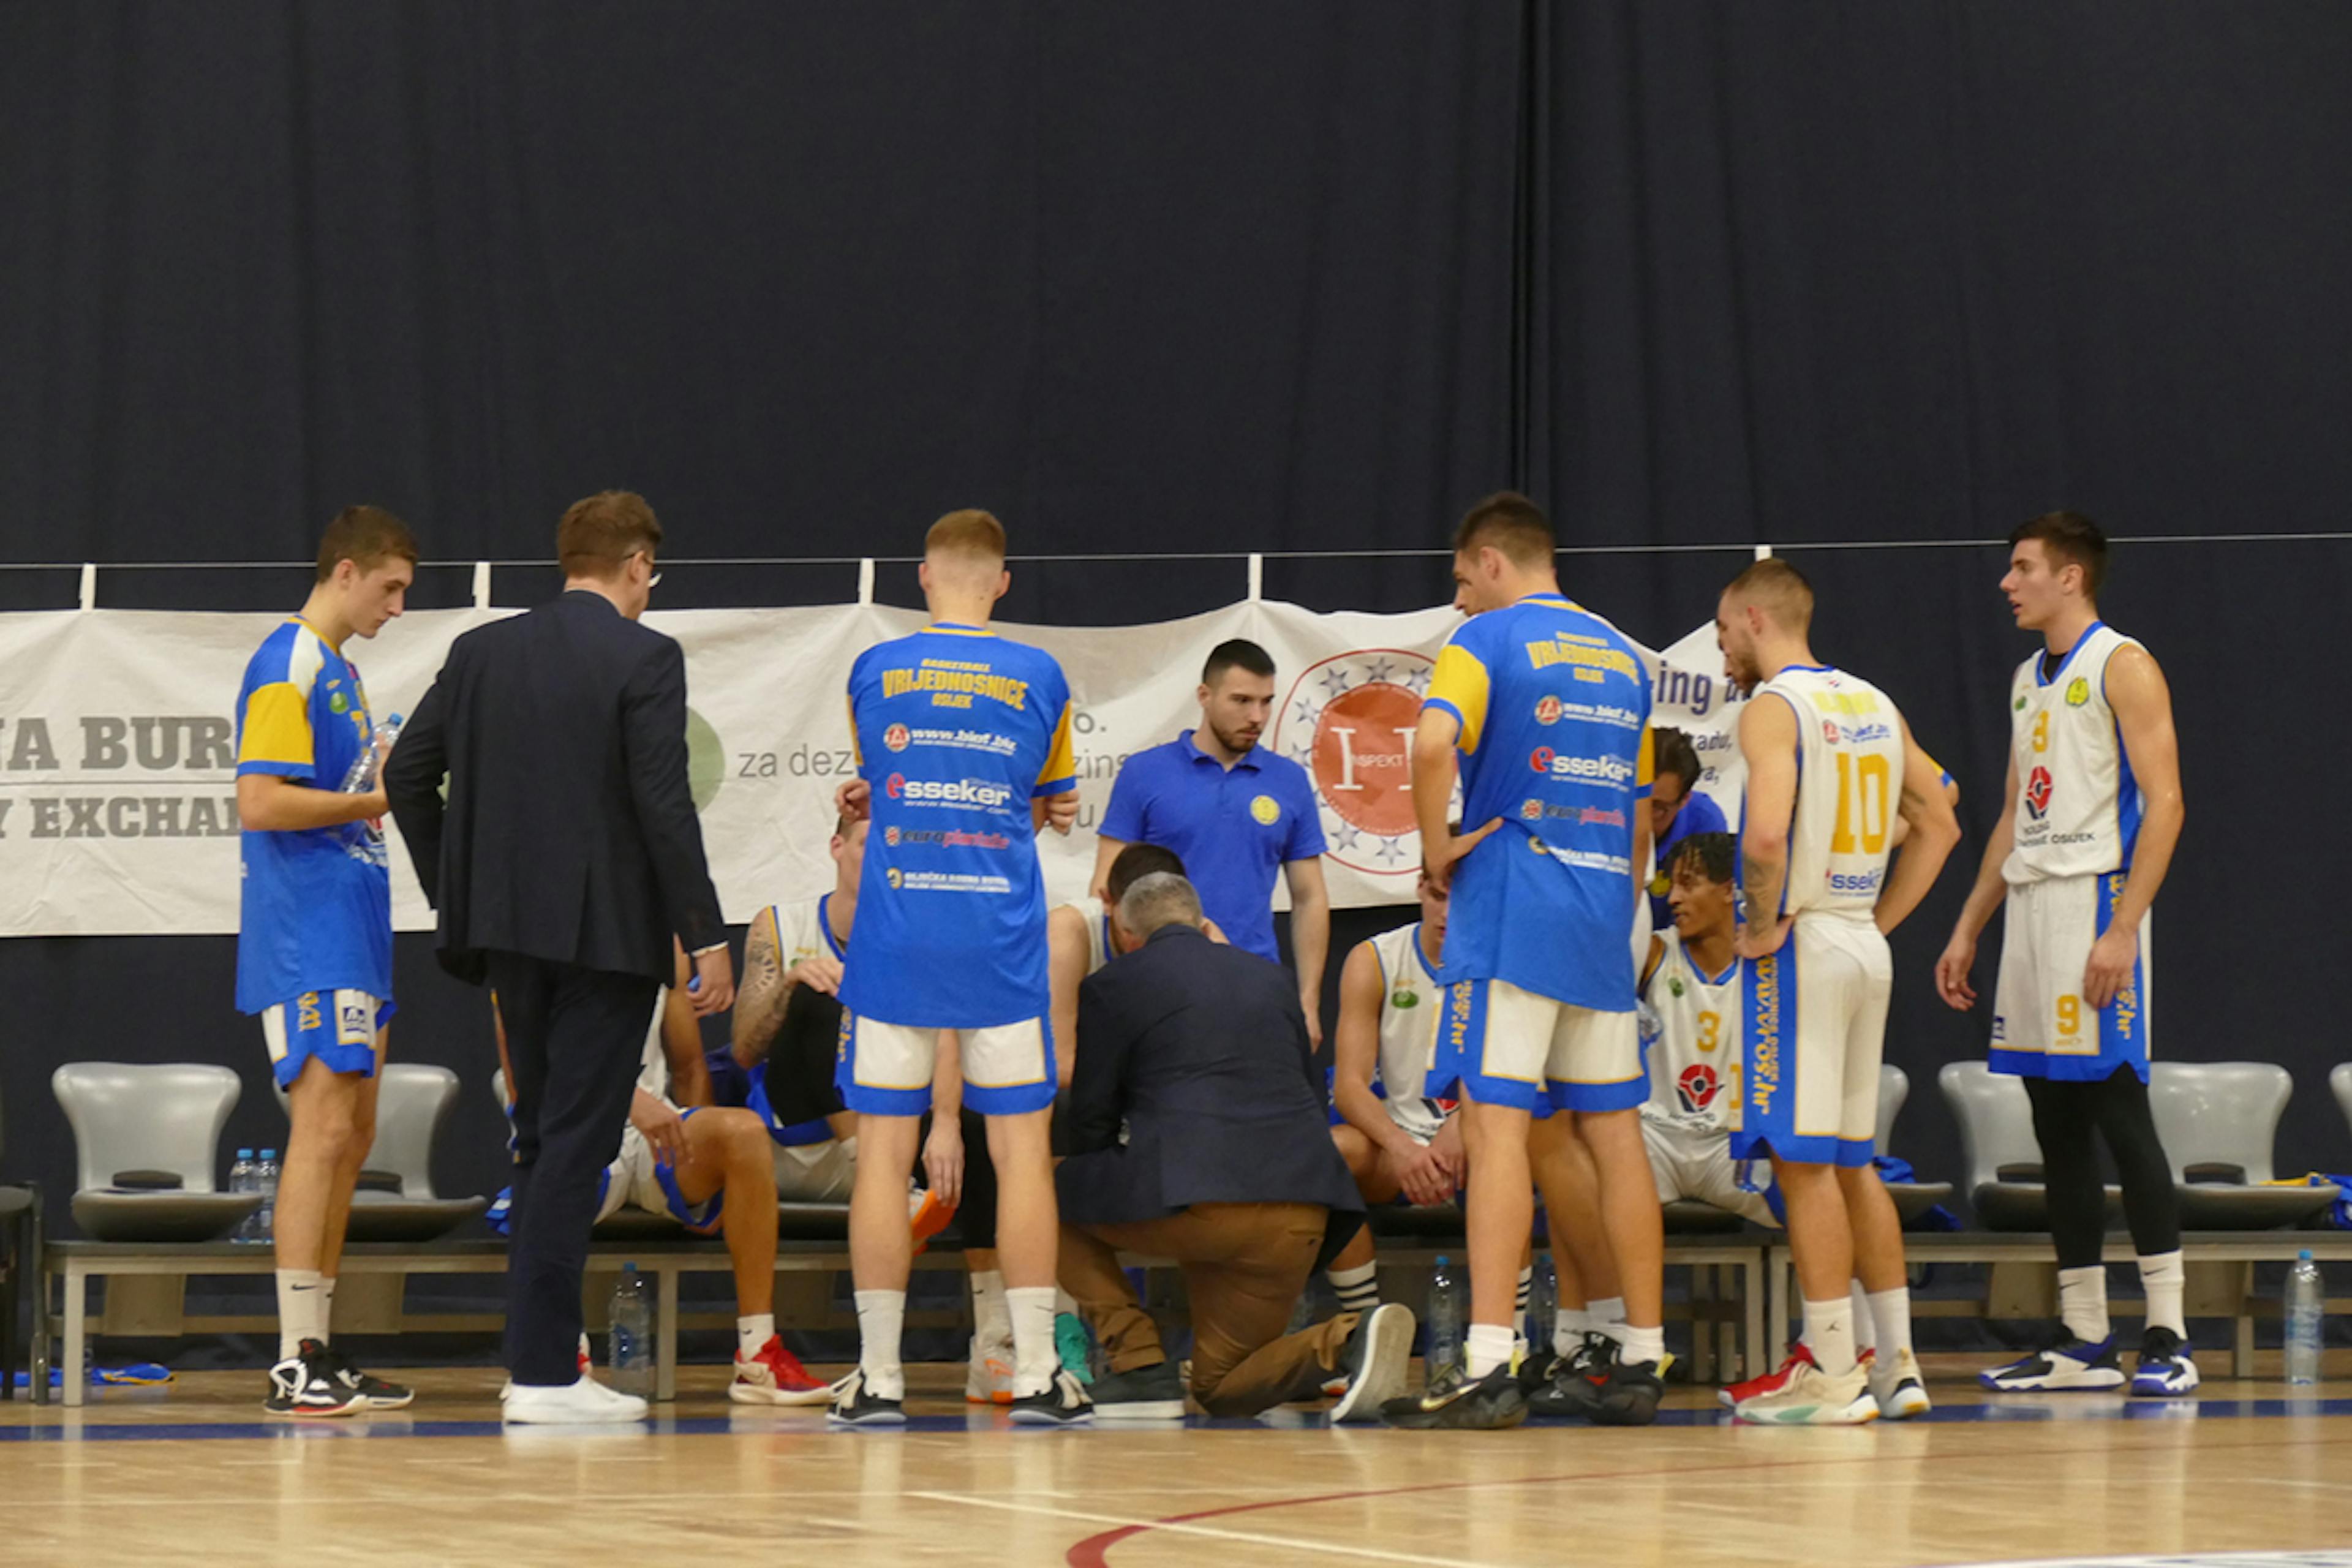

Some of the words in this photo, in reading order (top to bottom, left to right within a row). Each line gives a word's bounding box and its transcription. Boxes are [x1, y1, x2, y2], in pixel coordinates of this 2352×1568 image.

[882, 668, 1030, 710] VRIJEDNOSNICE
[1649, 660, 1712, 715] ing
[0, 717, 60, 770] A
[739, 752, 777, 777] za
[788, 743, 854, 777] dez
[1529, 745, 1634, 782] esseker
[887, 772, 1011, 806] esseker
[1830, 753, 1890, 854] 10
[1697, 1010, 1721, 1053] 3
[2057, 994, 2080, 1036] 9
